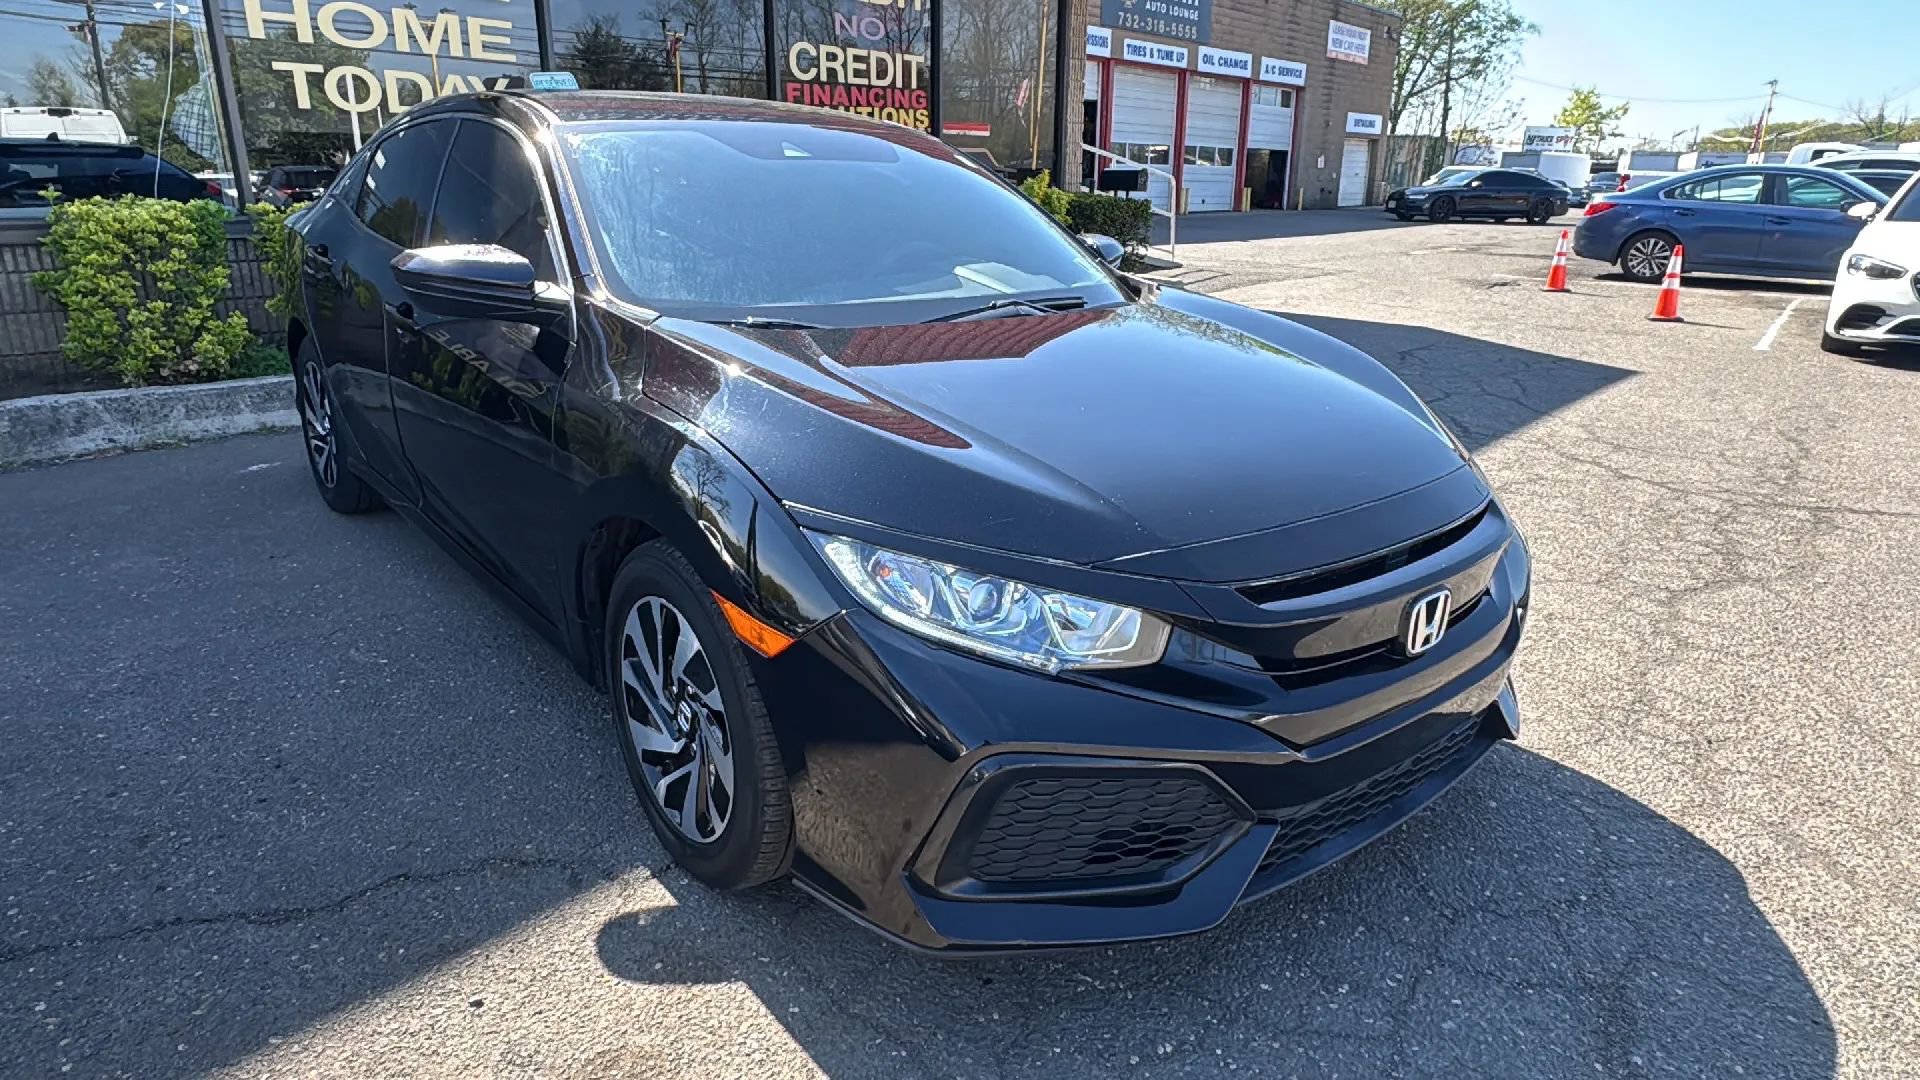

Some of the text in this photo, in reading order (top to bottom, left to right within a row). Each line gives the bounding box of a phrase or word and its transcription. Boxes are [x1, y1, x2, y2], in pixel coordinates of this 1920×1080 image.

[1146, 0, 1167, 12] AUTO
[1169, 5, 1199, 20] LOUNGE
[244, 0, 517, 62] HOME
[834, 12, 886, 41] NO
[788, 41, 925, 89] CREDIT
[1127, 44, 1184, 63] TIRES & TUNE UP
[1203, 53, 1249, 70] OIL CHANGE
[1278, 67, 1302, 78] SERVICE
[786, 82, 928, 109] FINANCING
